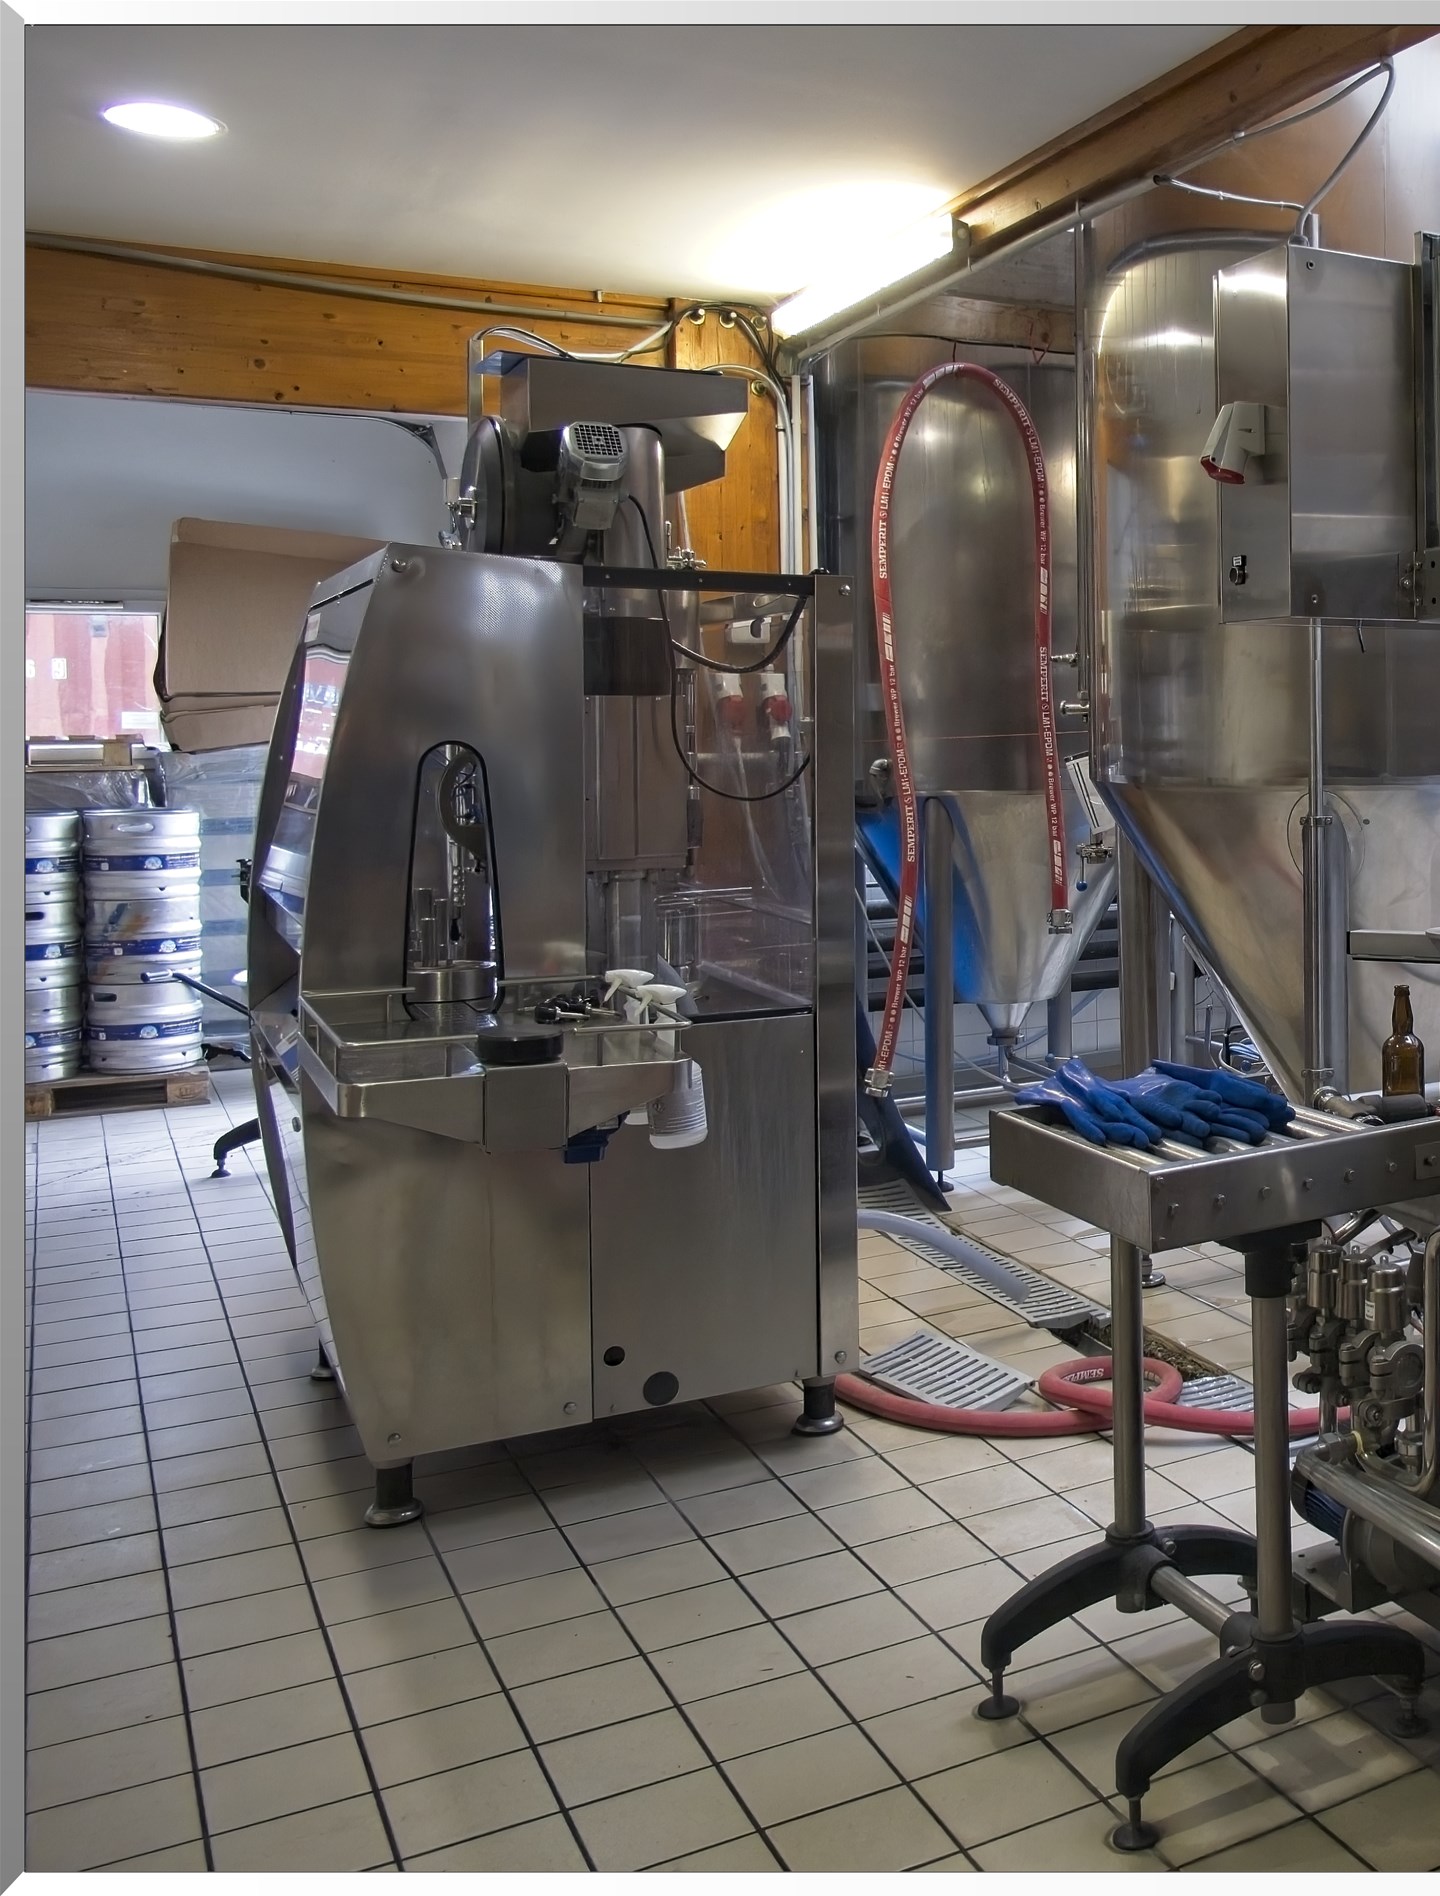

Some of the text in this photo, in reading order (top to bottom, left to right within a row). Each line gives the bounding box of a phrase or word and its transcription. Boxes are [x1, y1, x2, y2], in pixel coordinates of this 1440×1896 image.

[993, 379, 1031, 427] SEMPERIT
[878, 520, 888, 579] SEMPERIT
[1040, 646, 1048, 702] SEMPERIT
[1050, 803, 1057, 815] WP
[905, 805, 915, 862] SEMPERIT
[892, 983, 901, 1008] Brewer
[896, 970, 904, 982] WP
